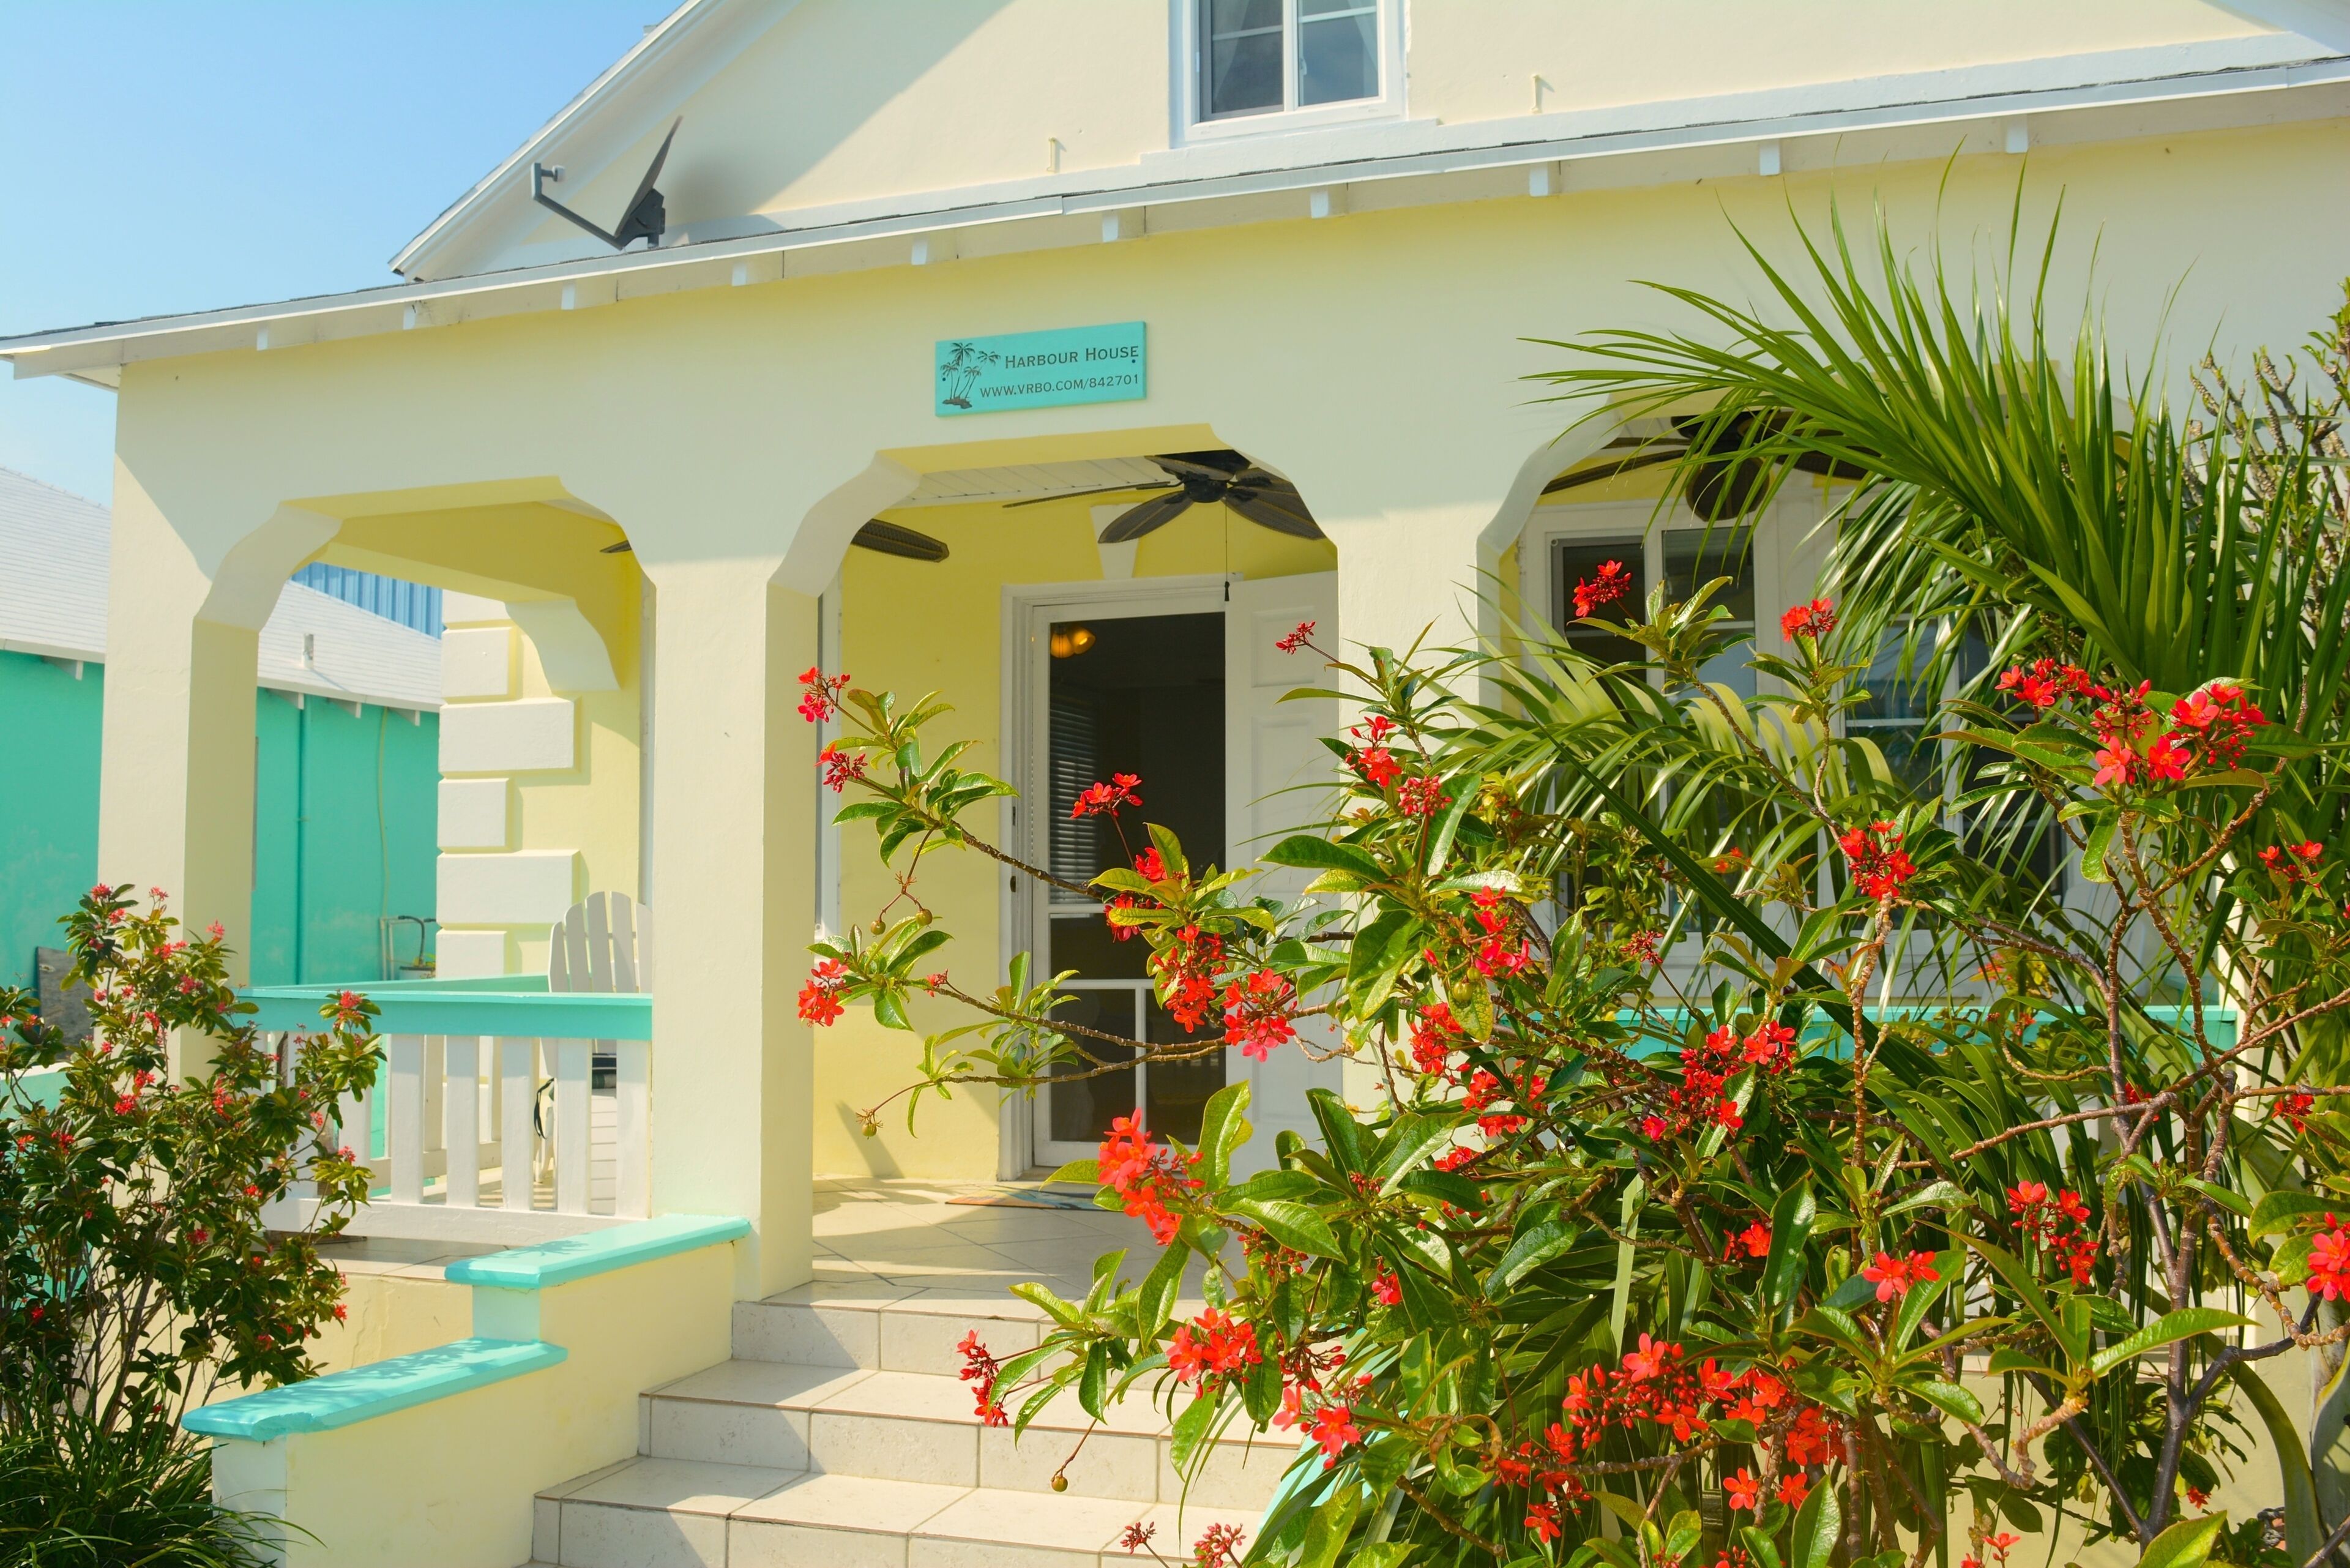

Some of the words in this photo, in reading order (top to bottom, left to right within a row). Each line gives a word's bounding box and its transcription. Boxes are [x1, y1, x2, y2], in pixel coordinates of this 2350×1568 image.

[1005, 351, 1078, 369] HARBOUR
[1086, 345, 1139, 361] HOUSE
[980, 374, 1138, 398] WWW.VRBO.COM/842701
